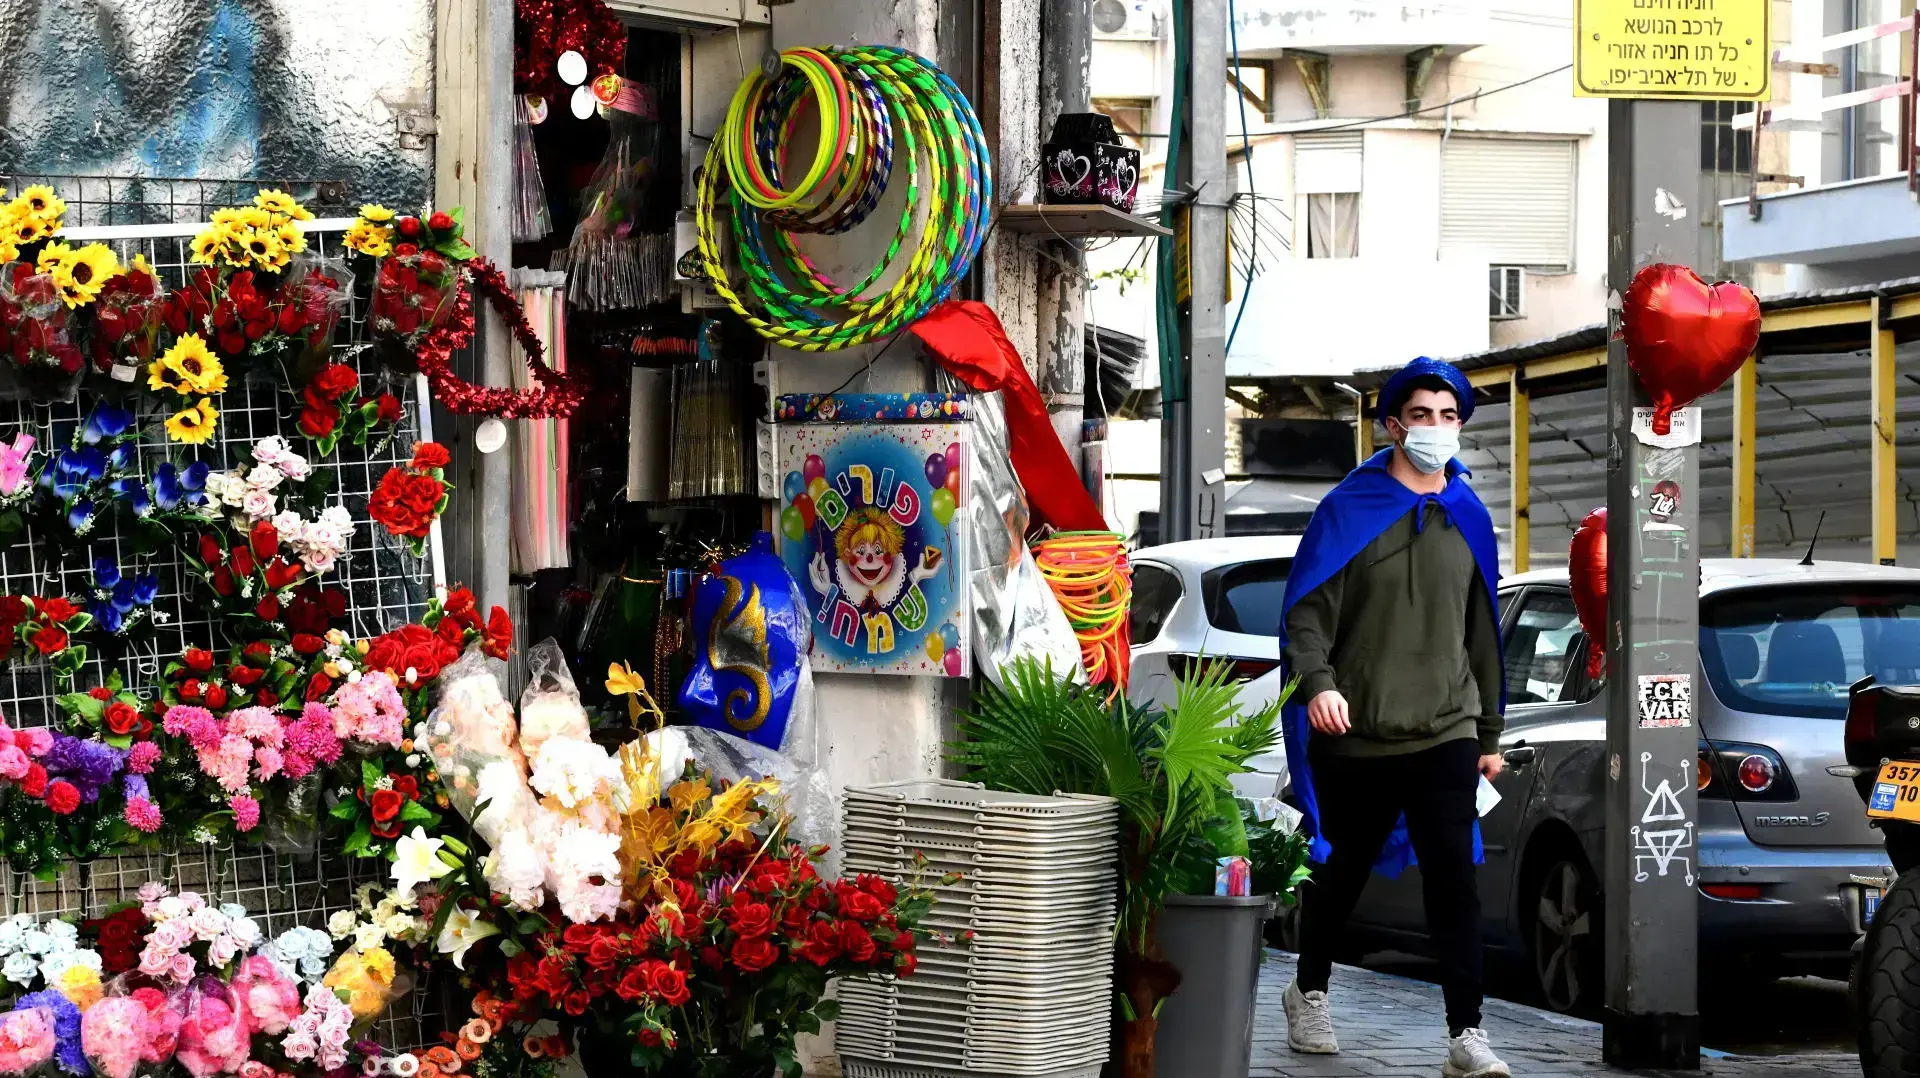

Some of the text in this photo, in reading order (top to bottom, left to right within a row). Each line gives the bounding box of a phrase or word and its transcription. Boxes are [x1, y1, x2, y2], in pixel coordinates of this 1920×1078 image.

[1624, 17, 1723, 36] לרכב הנושא
[1607, 41, 1739, 62] כל תו חניה אזורי
[1713, 66, 1737, 87] של
[815, 464, 921, 531] פורים
[816, 583, 928, 654] שמח!
[1639, 681, 1690, 701] FCK
[1640, 700, 1690, 720] VAR
[1886, 765, 1920, 782] 357
[1899, 784, 1919, 803] 10
[1811, 811, 1830, 827] 3
